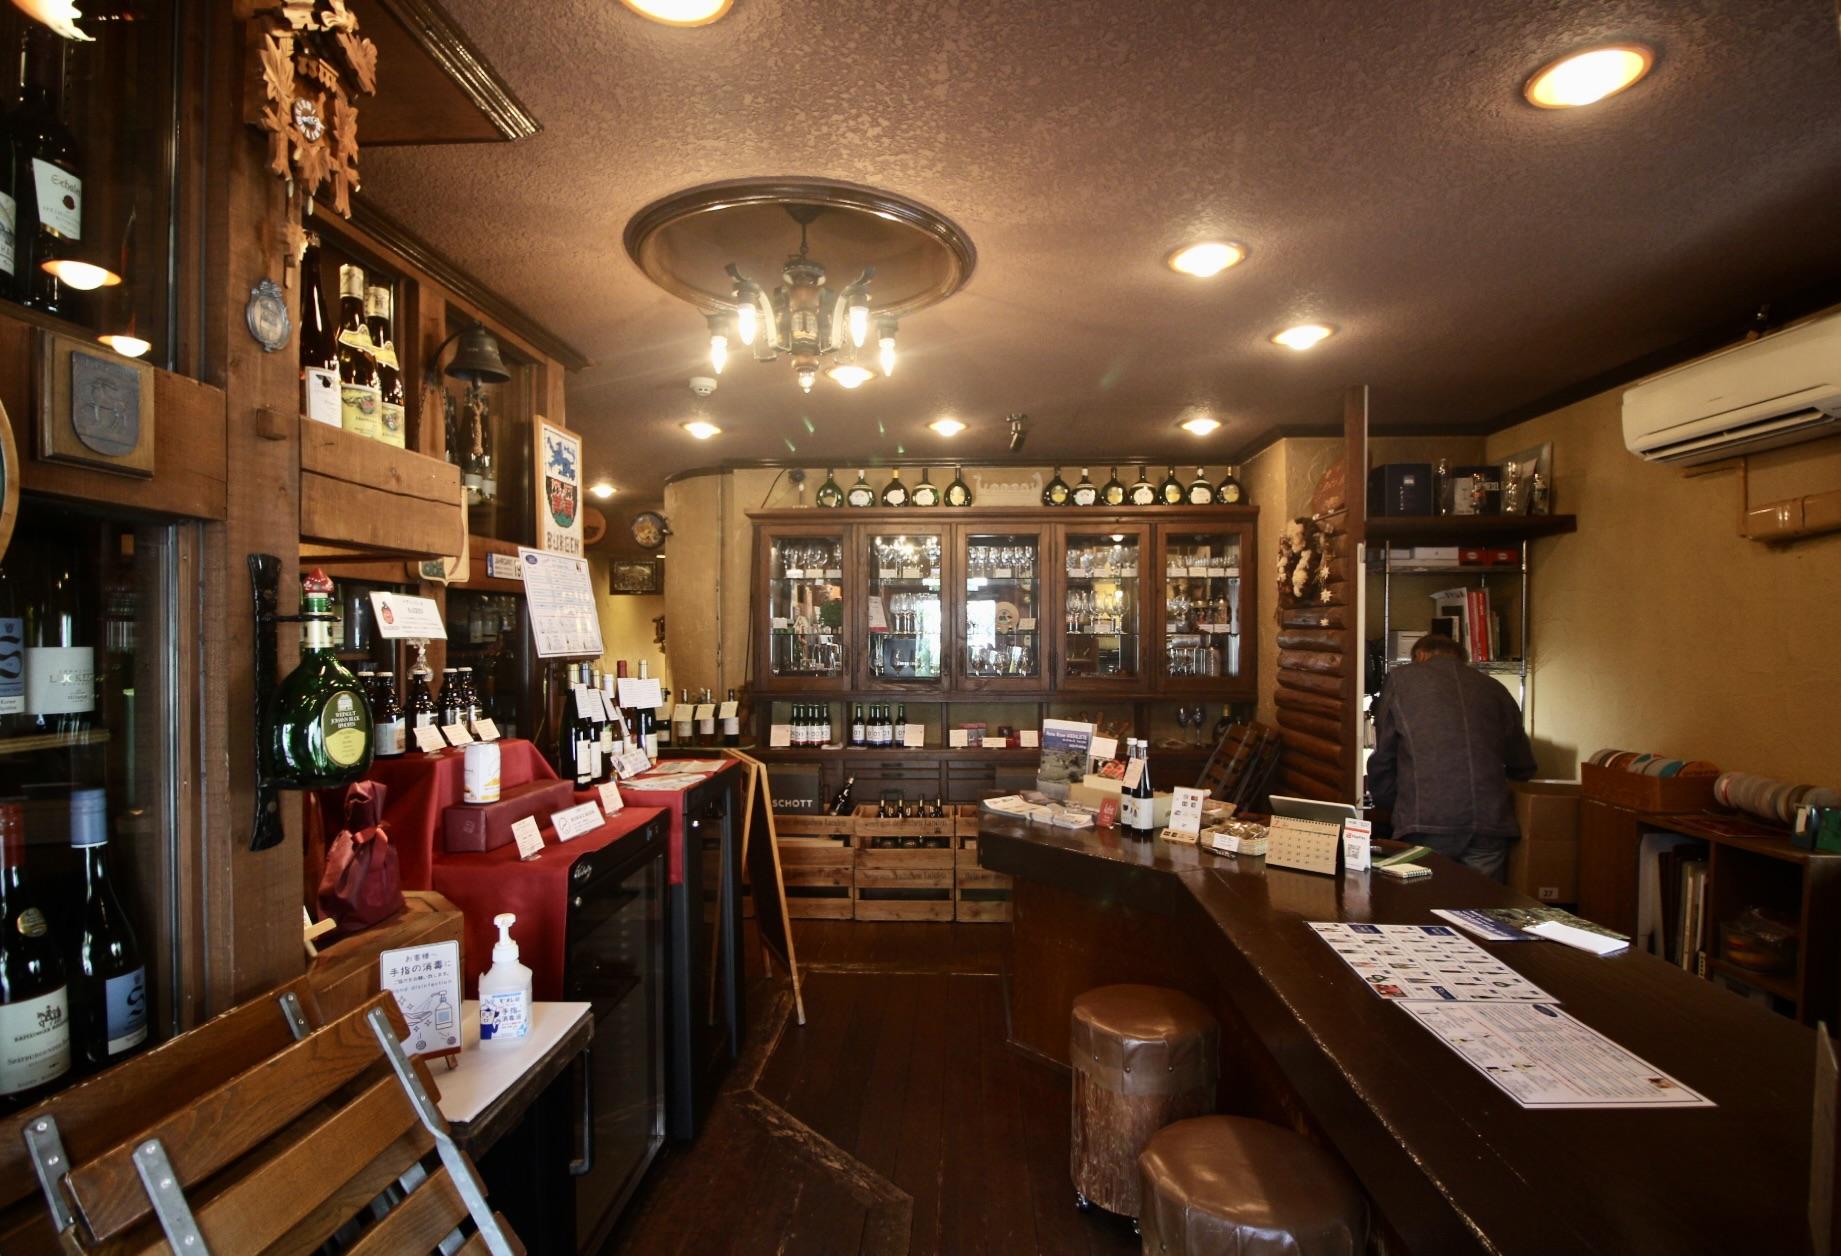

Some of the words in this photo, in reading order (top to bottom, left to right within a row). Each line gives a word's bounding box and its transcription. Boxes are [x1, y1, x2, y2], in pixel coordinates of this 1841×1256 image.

[771, 799, 813, 808] SCHOTT
[388, 960, 452, 977] 手指の消毒に
